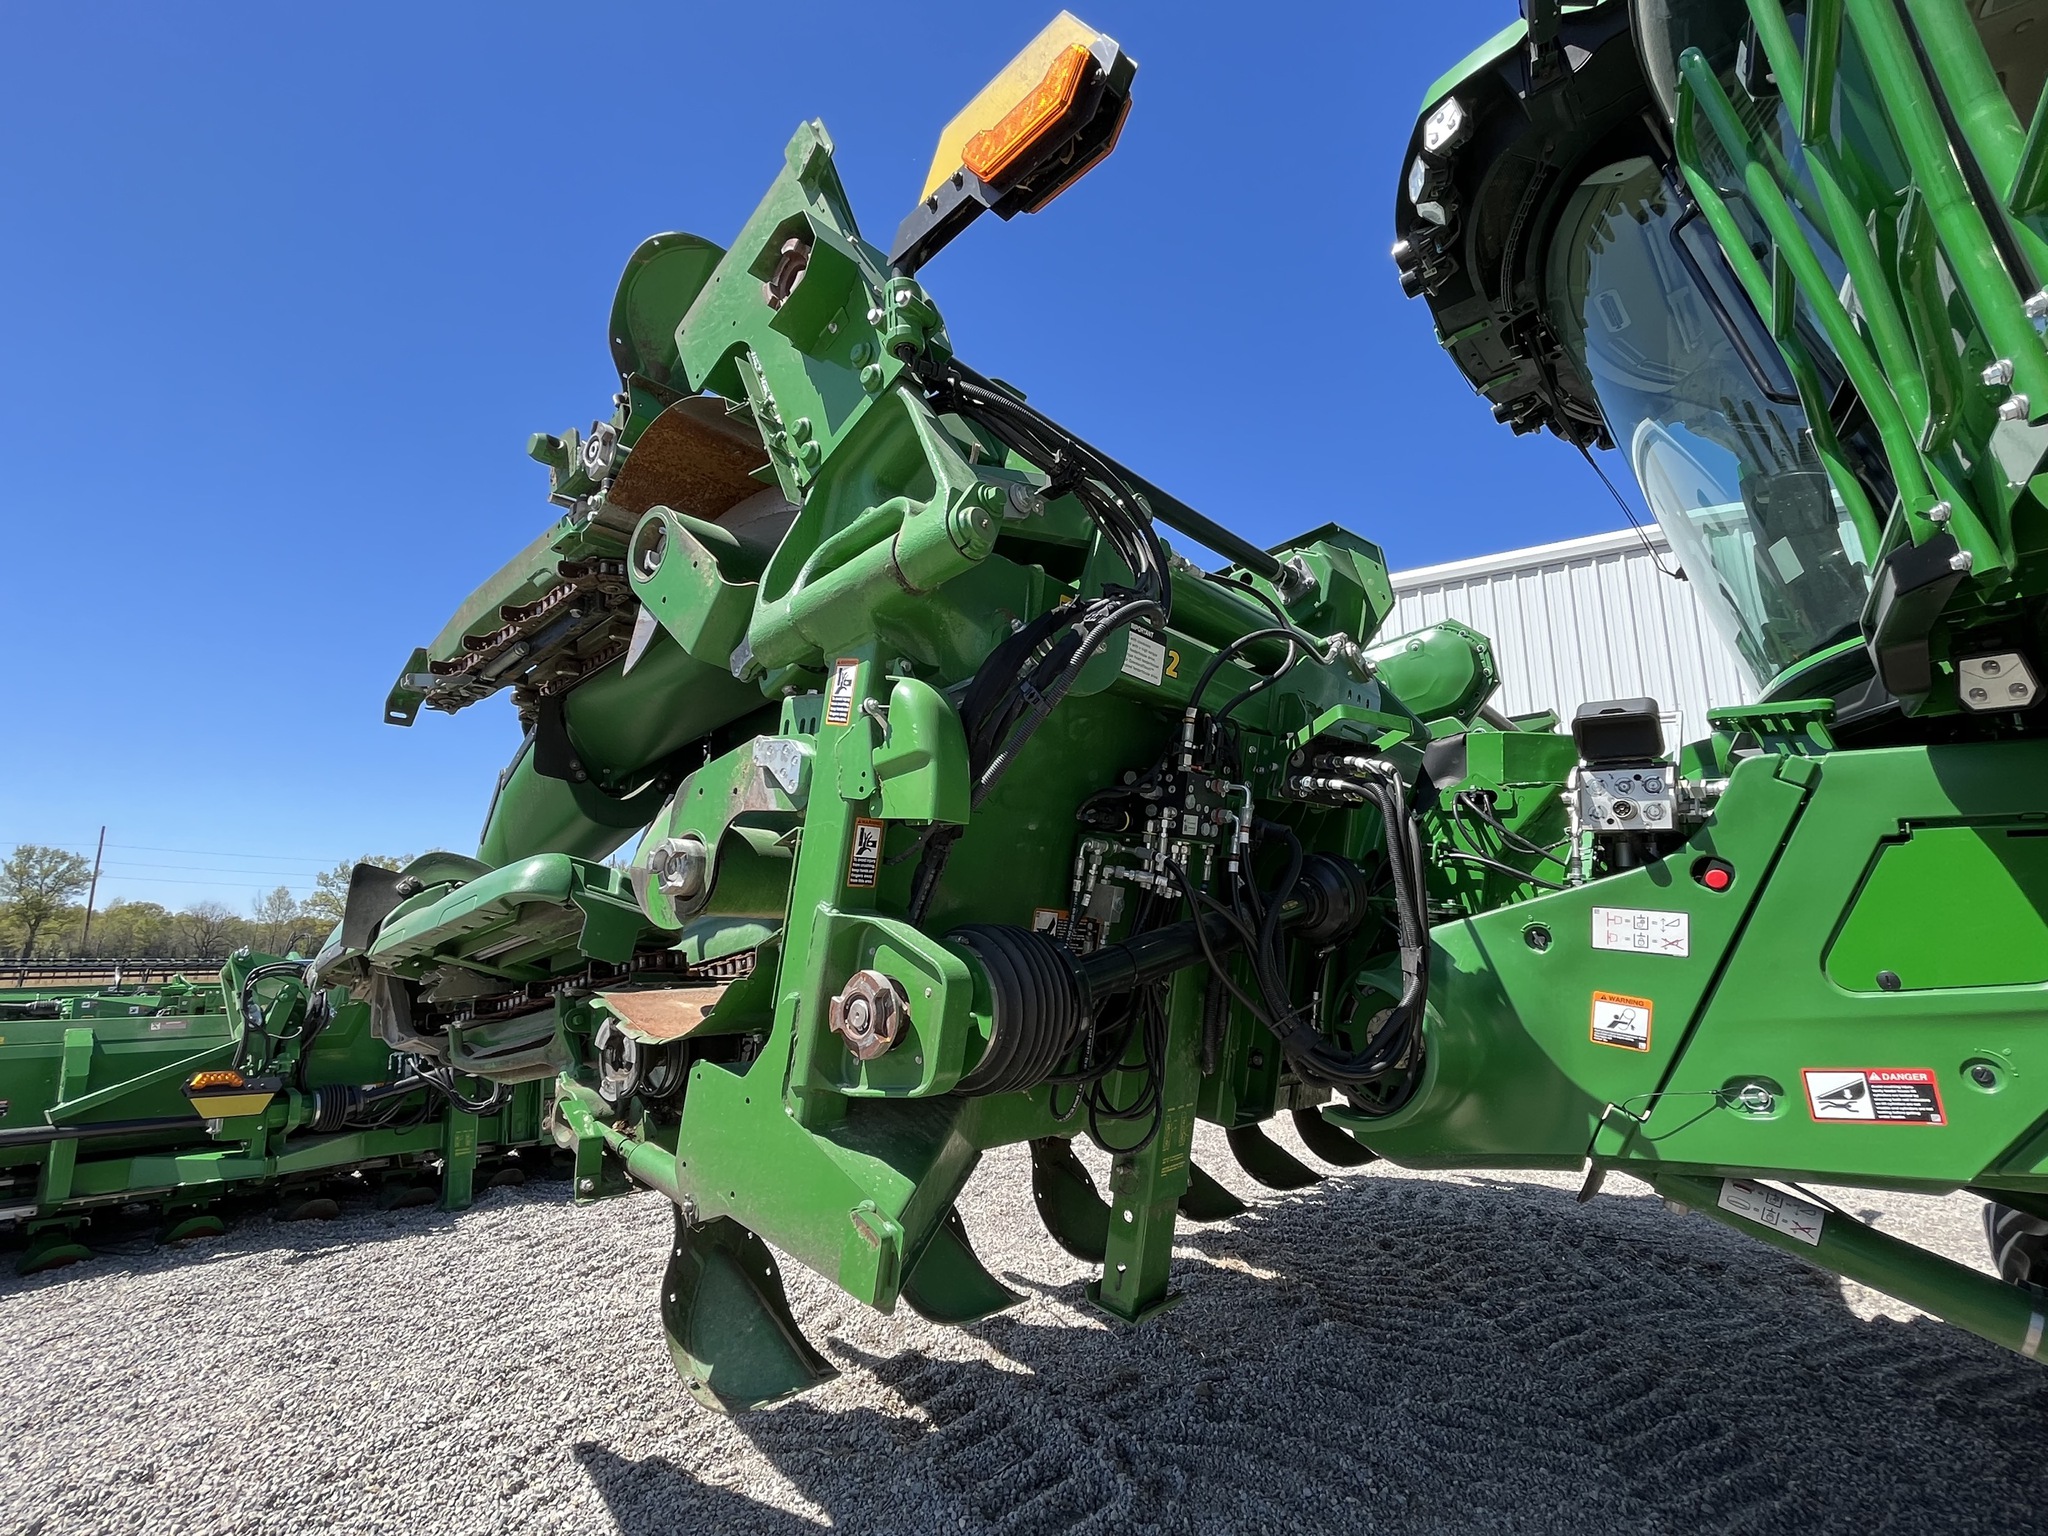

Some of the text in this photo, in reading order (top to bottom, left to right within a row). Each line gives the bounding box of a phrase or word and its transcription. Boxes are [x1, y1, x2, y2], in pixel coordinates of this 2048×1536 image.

[1165, 650, 1180, 678] 2
[1608, 995, 1644, 1006] WARNING
[1881, 1073, 1928, 1081] DANGER
